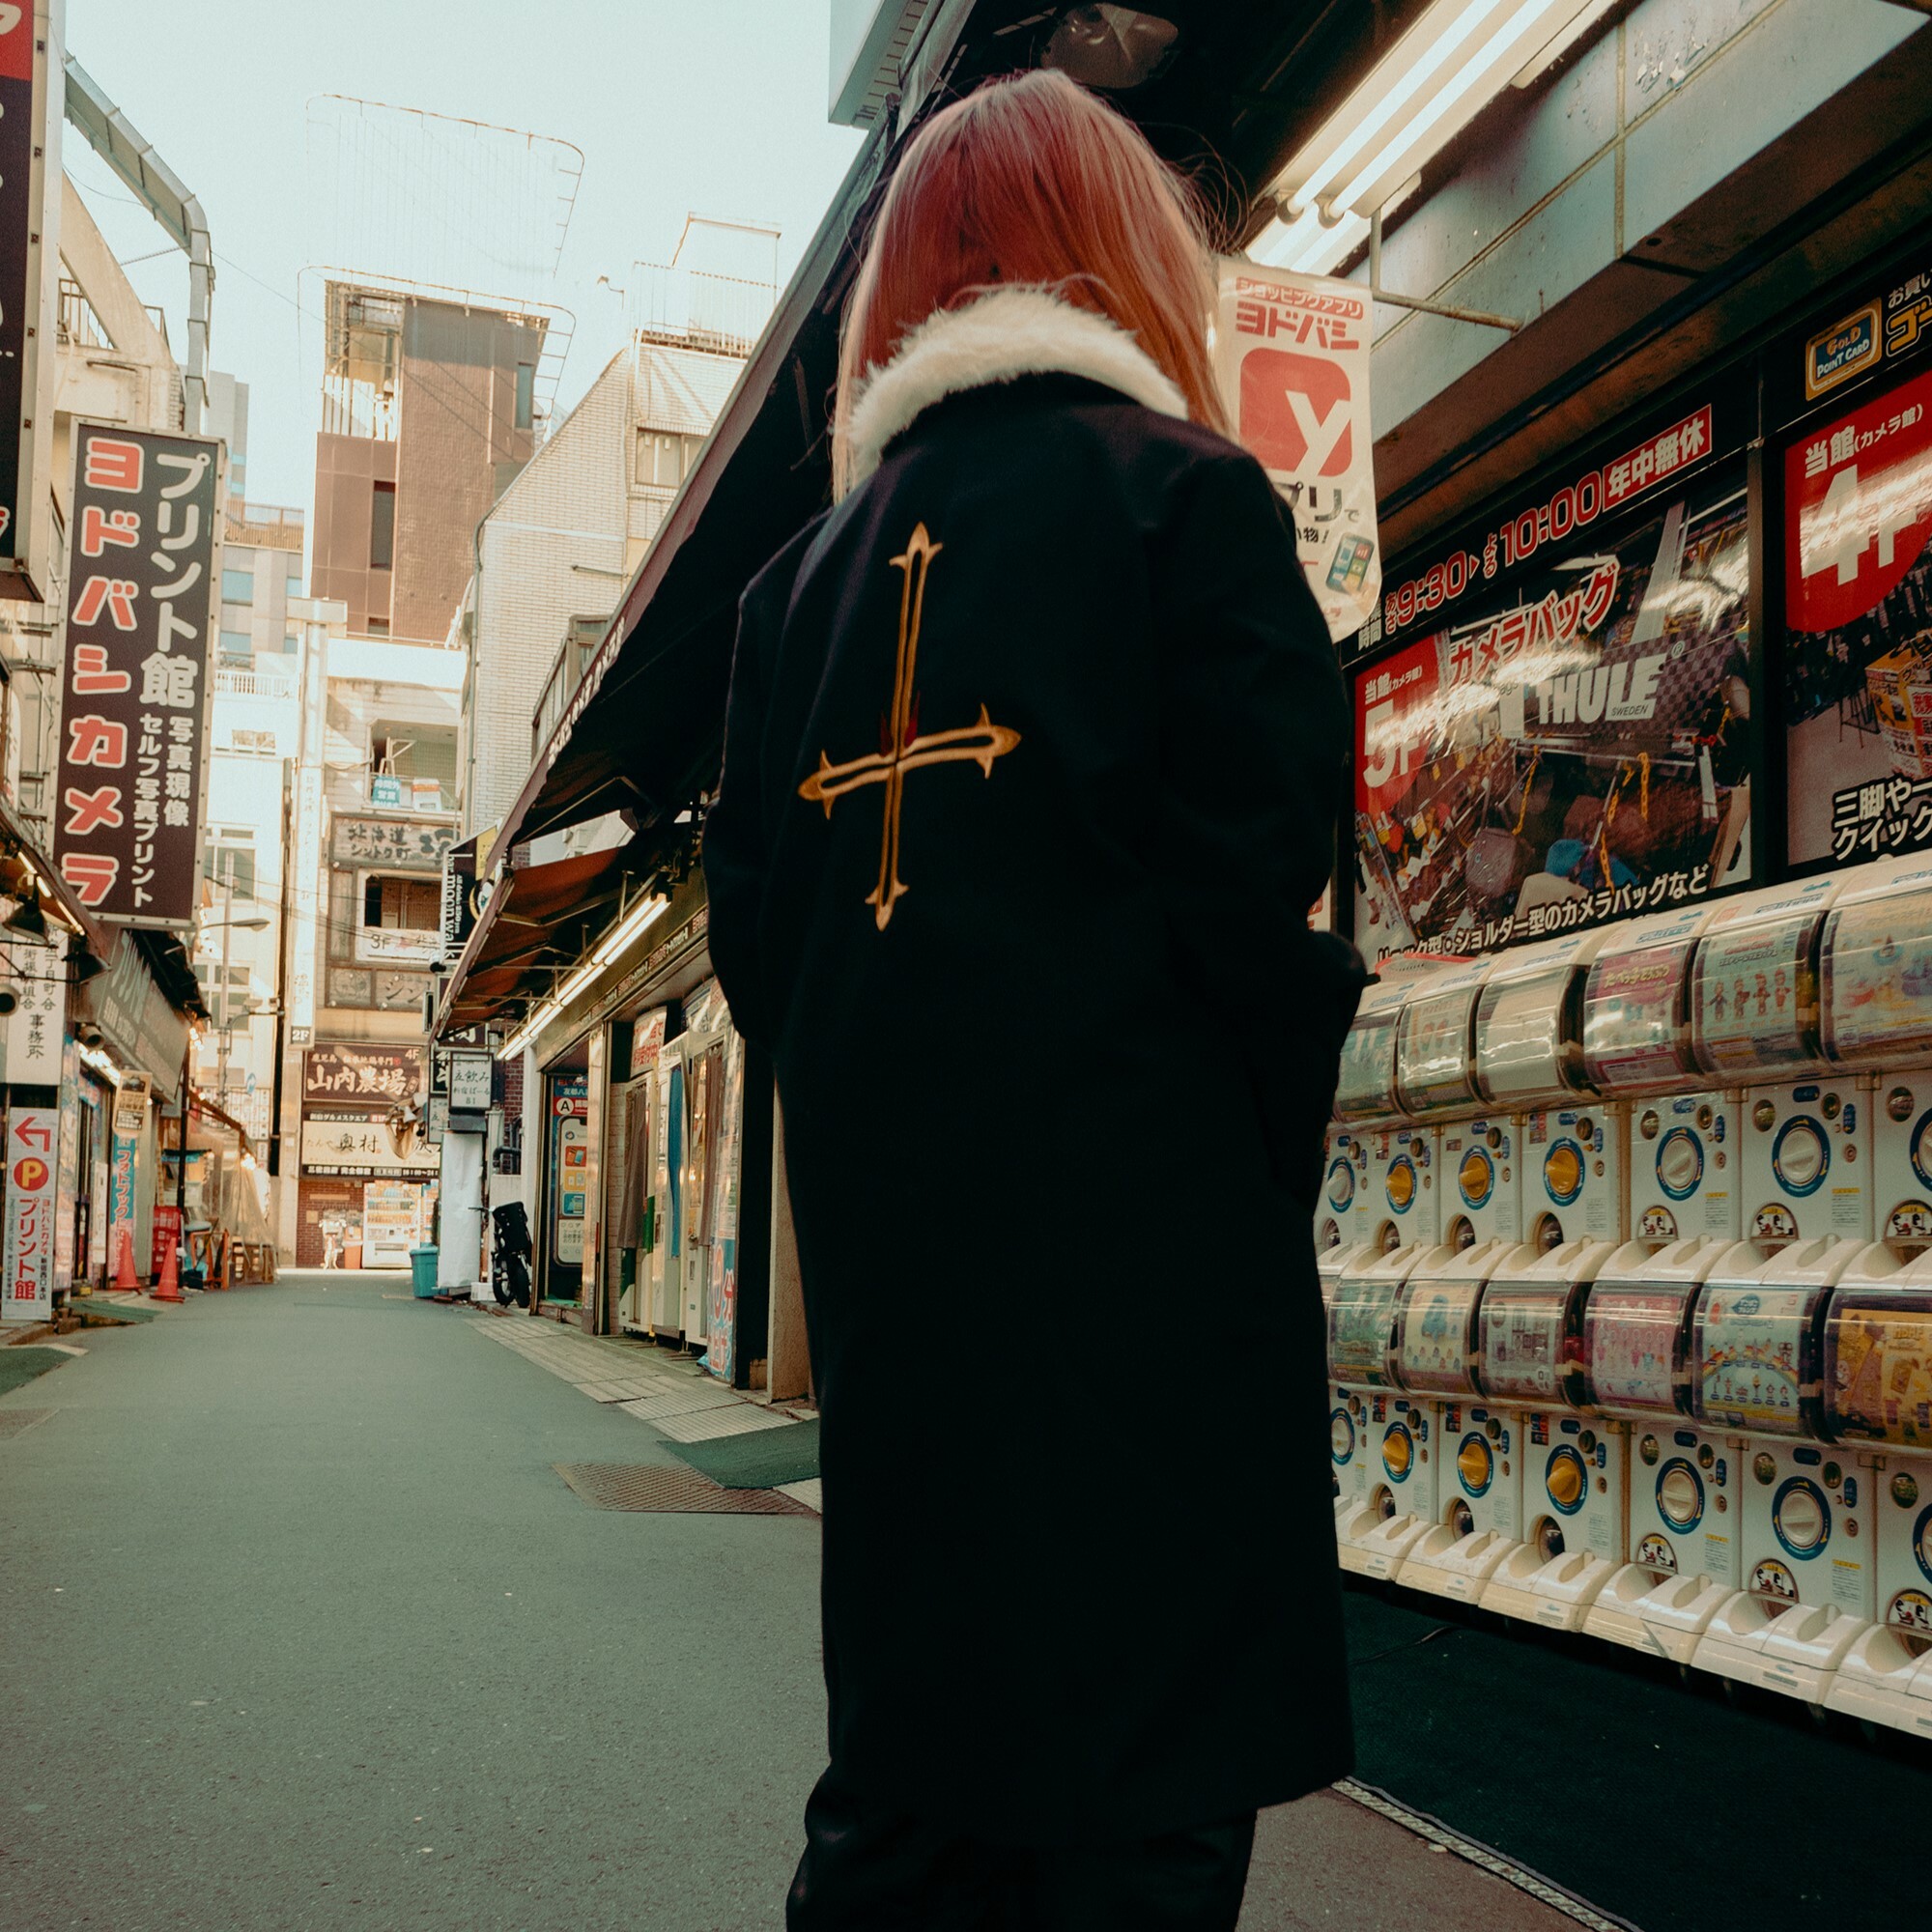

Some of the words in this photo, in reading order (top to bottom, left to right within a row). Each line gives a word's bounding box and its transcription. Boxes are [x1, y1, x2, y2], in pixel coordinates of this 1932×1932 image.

[1238, 278, 1361, 317] ショッピングアプリ
[1236, 300, 1359, 350] ヨドバシ
[1826, 326, 1861, 355] GOLD
[1816, 352, 1843, 379] POINT
[1845, 339, 1870, 360] CARD
[1607, 416, 1705, 498] 年中無休
[1804, 424, 1856, 479] 当館
[1801, 464, 1917, 586] 4F
[1384, 591, 1397, 635] あさ
[1396, 551, 1467, 627] 9:30
[1483, 533, 1497, 578] よる
[1500, 470, 1603, 567] 10:00
[139, 452, 213, 710] プリント館
[1358, 621, 1382, 651] 時間
[1449, 560, 1621, 684] カメラバッグ
[62, 437, 146, 906] ヨドバシカメラ
[1365, 671, 1391, 705] 当館
[1536, 652, 1668, 725] THULE
[1610, 704, 1649, 717] SWEDEN
[163, 716, 194, 828] 写真現像
[131, 713, 163, 908] セルフ写真プリント
[348, 823, 409, 846] 北海道
[371, 933, 391, 950] 3F
[26, 1013, 45, 1059] 事務所
[292, 1030, 310, 1041] 2F
[405, 1048, 421, 1060] 4F
[307, 1064, 408, 1096] 山内農場
[560, 1100, 570, 1112] A
[335, 1132, 379, 1153] 奥村
[21, 1160, 43, 1188] P
[14, 1197, 40, 1301] プリント館
